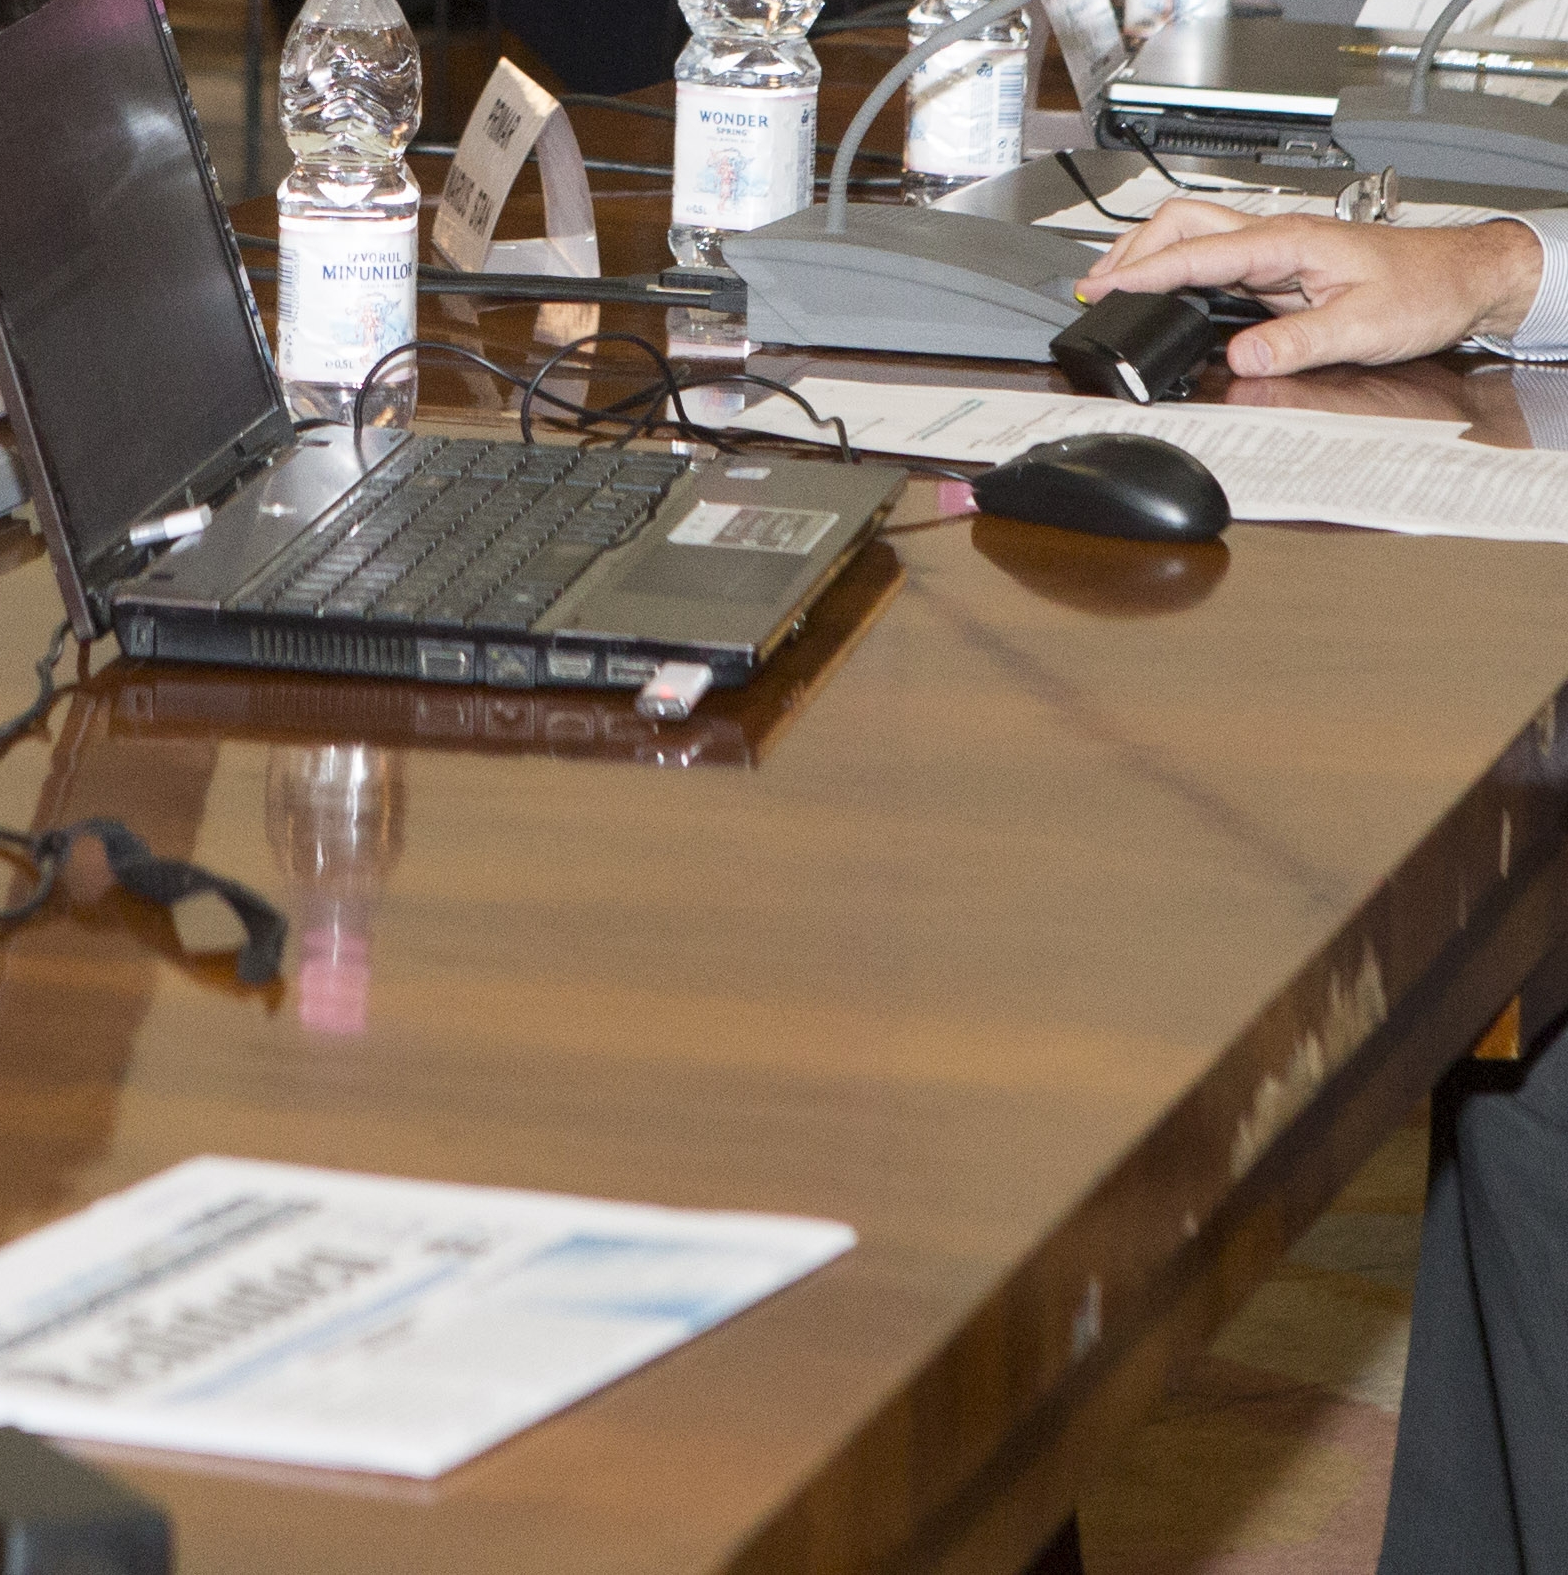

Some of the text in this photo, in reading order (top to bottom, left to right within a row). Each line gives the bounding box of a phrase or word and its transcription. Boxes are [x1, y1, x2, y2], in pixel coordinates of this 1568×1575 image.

[483, 98, 522, 152] PRIMAR
[699, 110, 770, 128] WONDER
[716, 127, 748, 137] SPRING
[348, 252, 402, 264] IZVORUL
[322, 262, 413, 281] MINUNILOR
